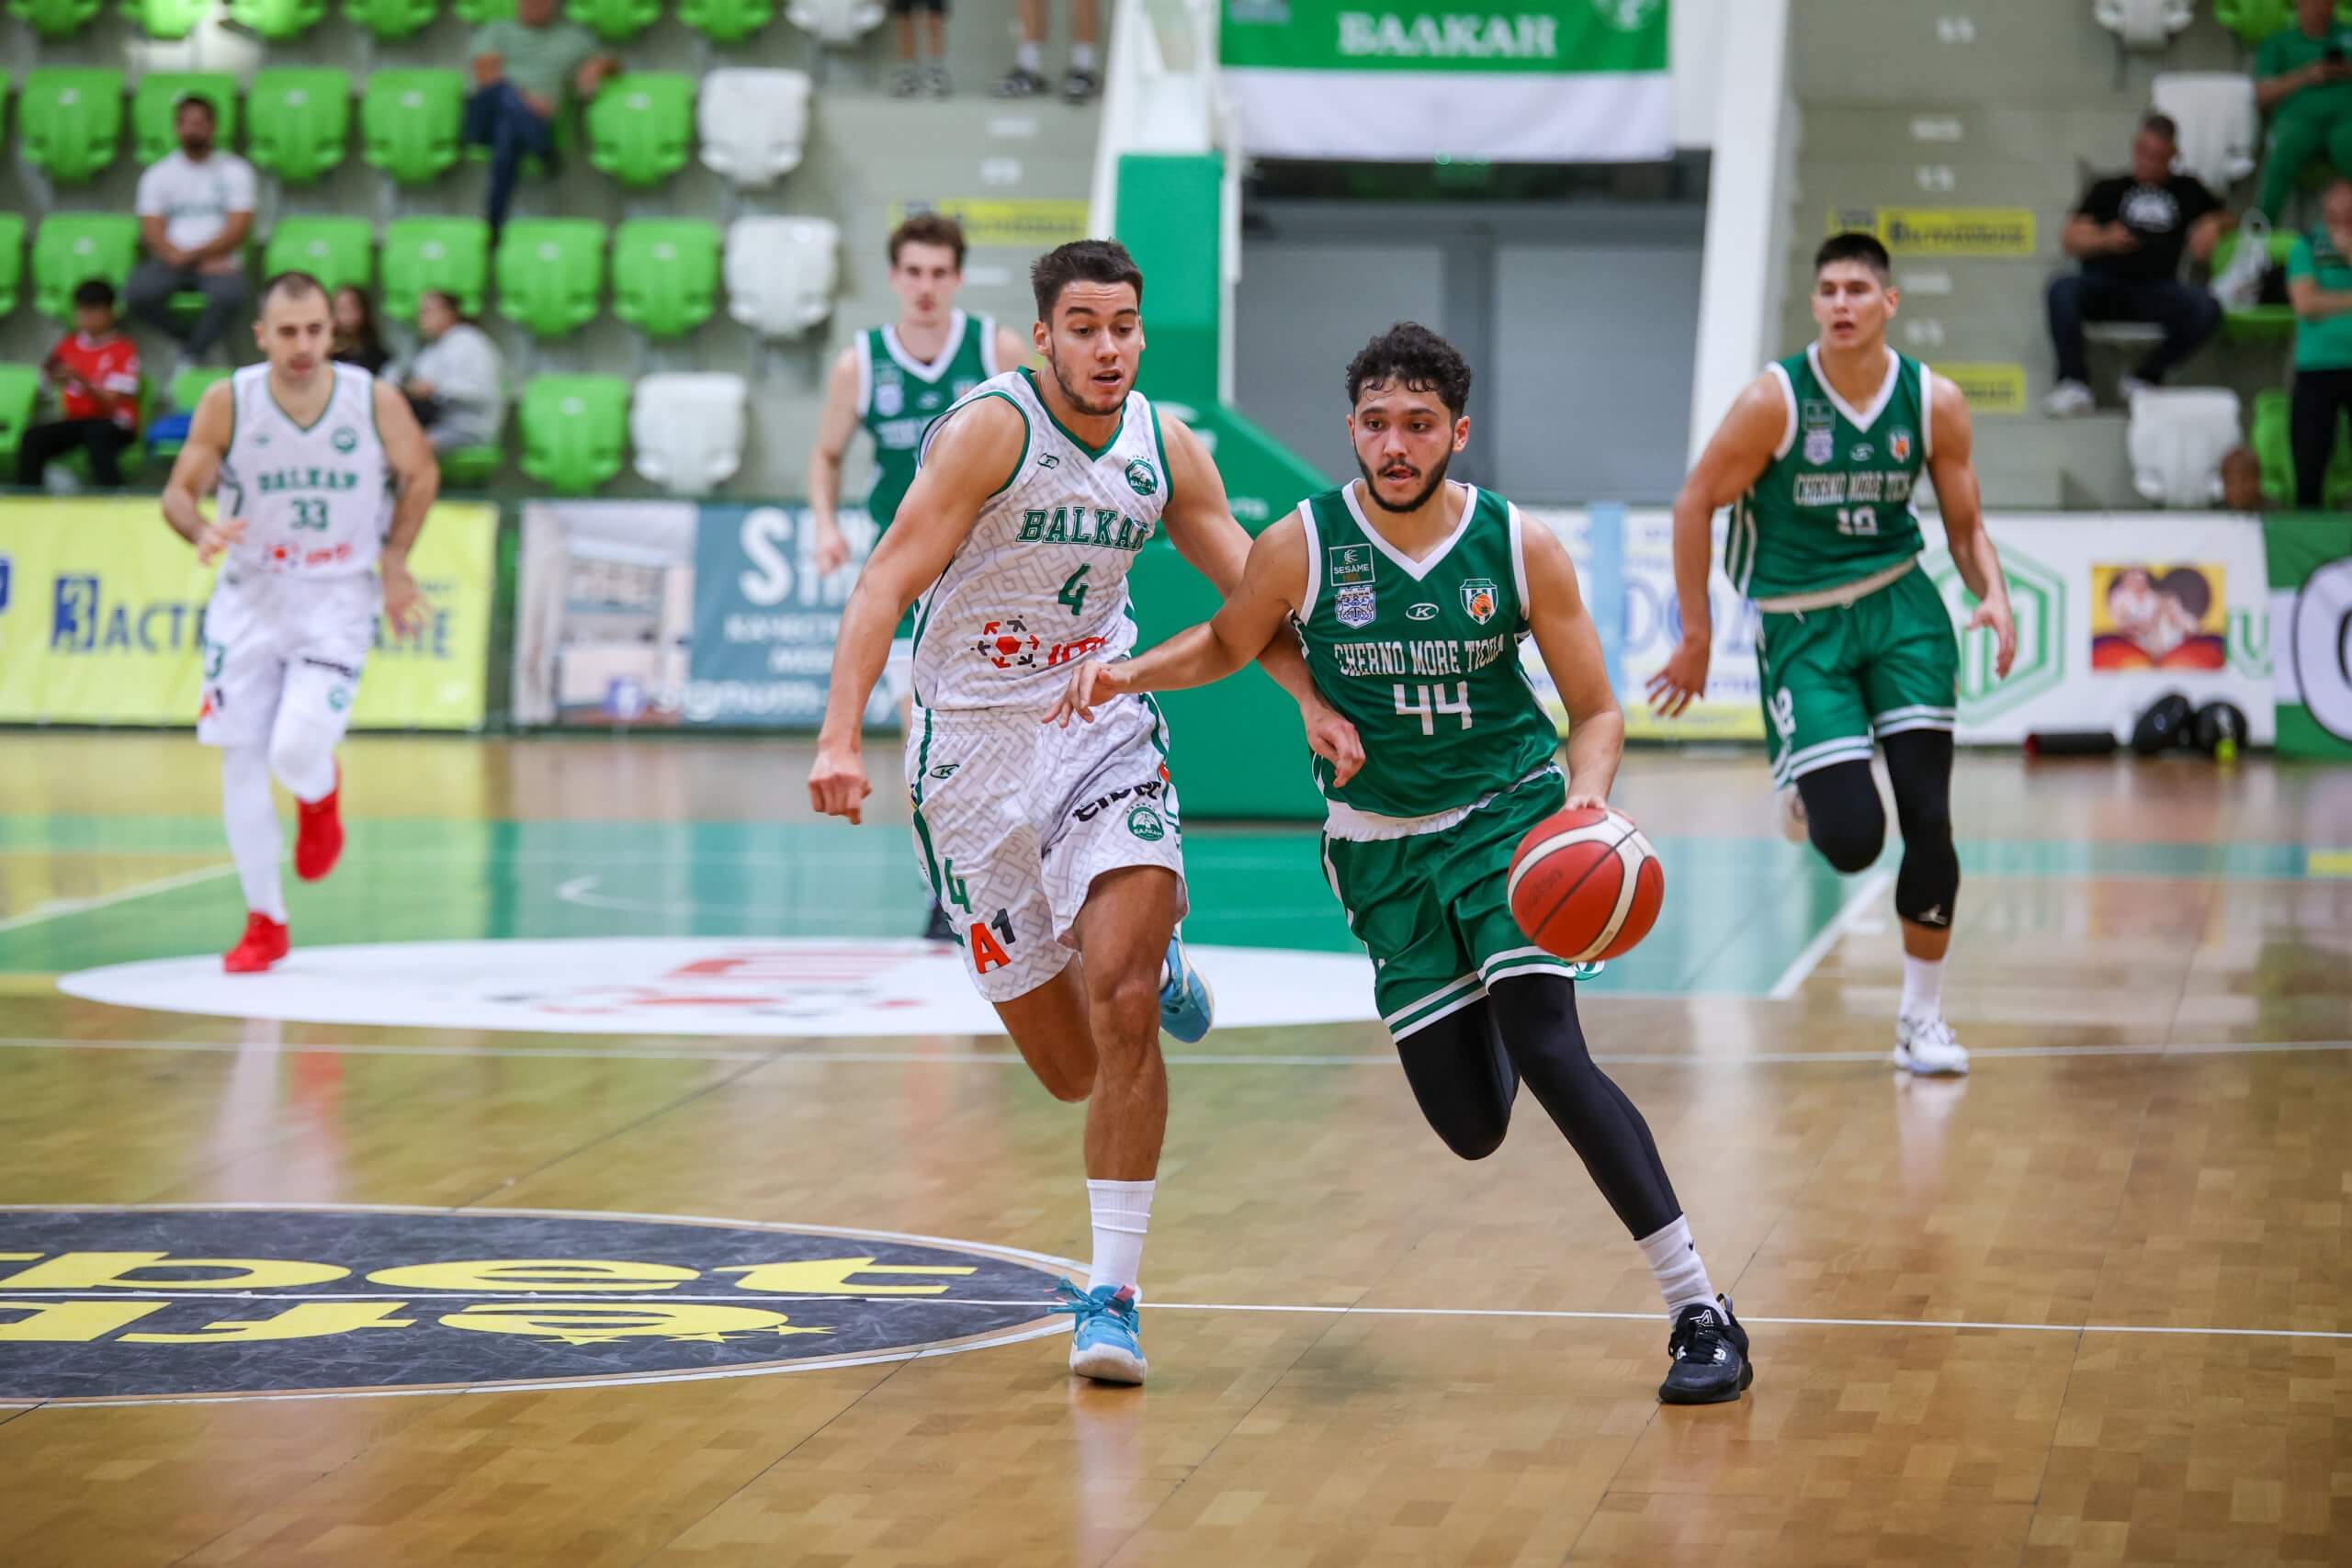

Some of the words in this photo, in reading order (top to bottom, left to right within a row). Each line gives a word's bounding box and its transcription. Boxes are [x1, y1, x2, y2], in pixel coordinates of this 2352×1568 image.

[289, 498, 329, 531] 33
[1058, 563, 1091, 616] 4
[1333, 563, 1370, 574] SESAME
[1334, 641, 1406, 677] CHERNO
[1409, 640, 1462, 676] MORE
[1394, 681, 1473, 735] 44
[944, 857, 973, 914] 4
[970, 908, 1016, 975] A1
[0, 1251, 978, 1295] bet
